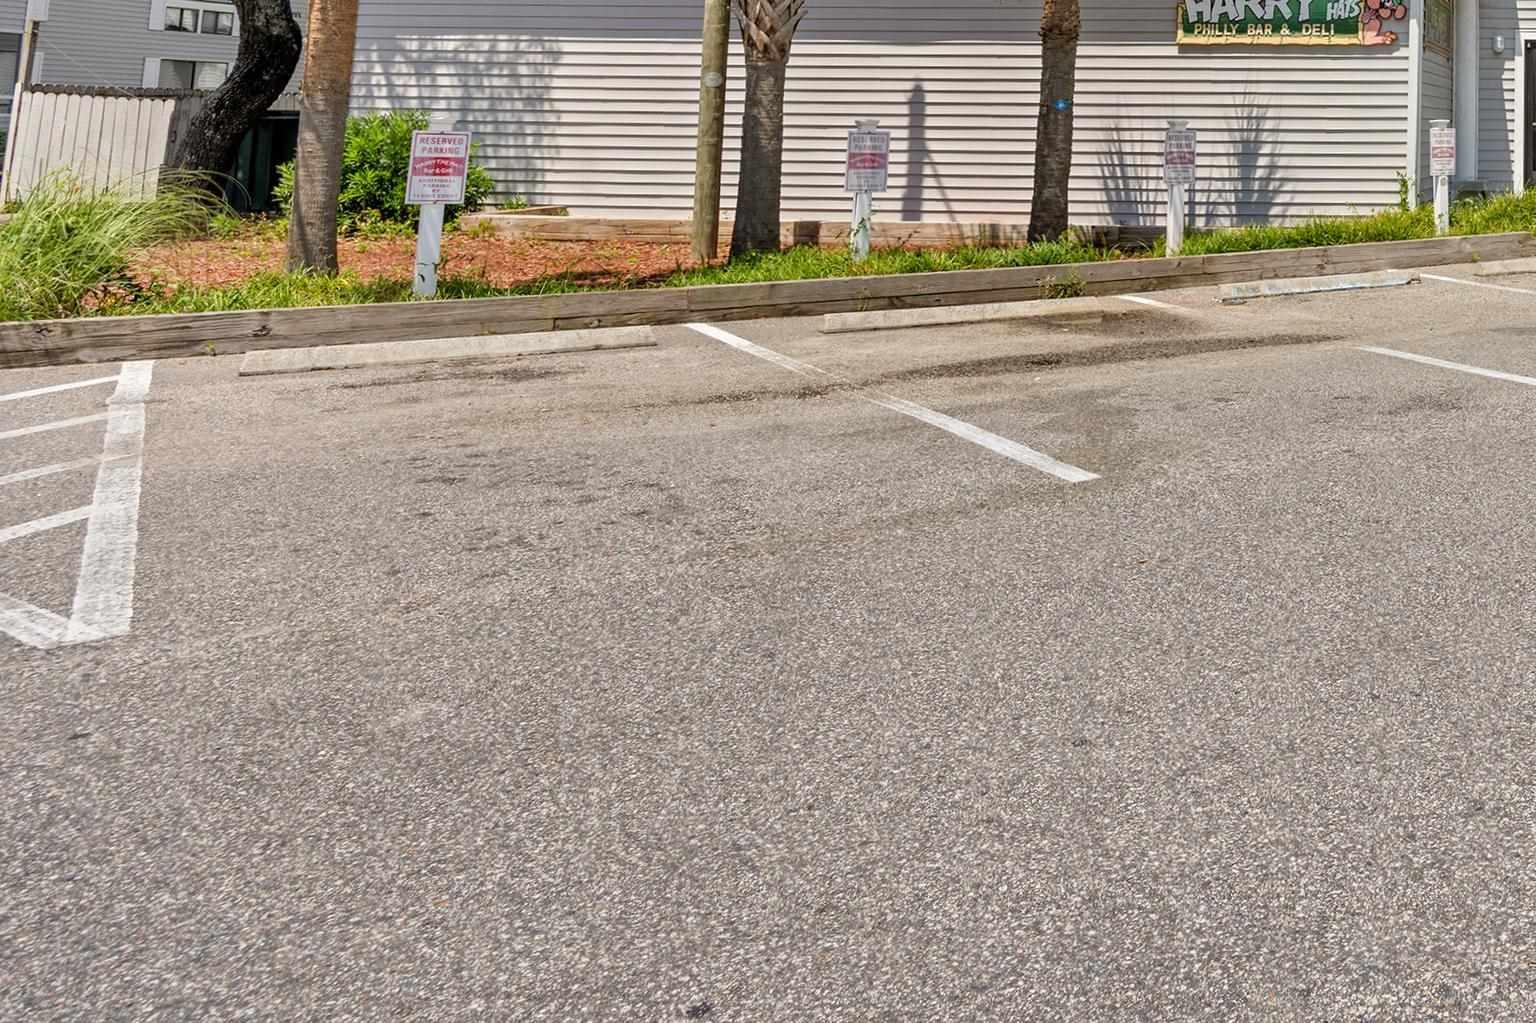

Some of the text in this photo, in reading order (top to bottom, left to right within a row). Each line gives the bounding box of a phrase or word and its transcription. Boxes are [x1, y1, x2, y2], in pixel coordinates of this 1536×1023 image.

[1194, 23, 1335, 36] PHILLY BAR & DELI
[419, 137, 464, 145] RESERVED
[421, 146, 460, 154] PARKING
